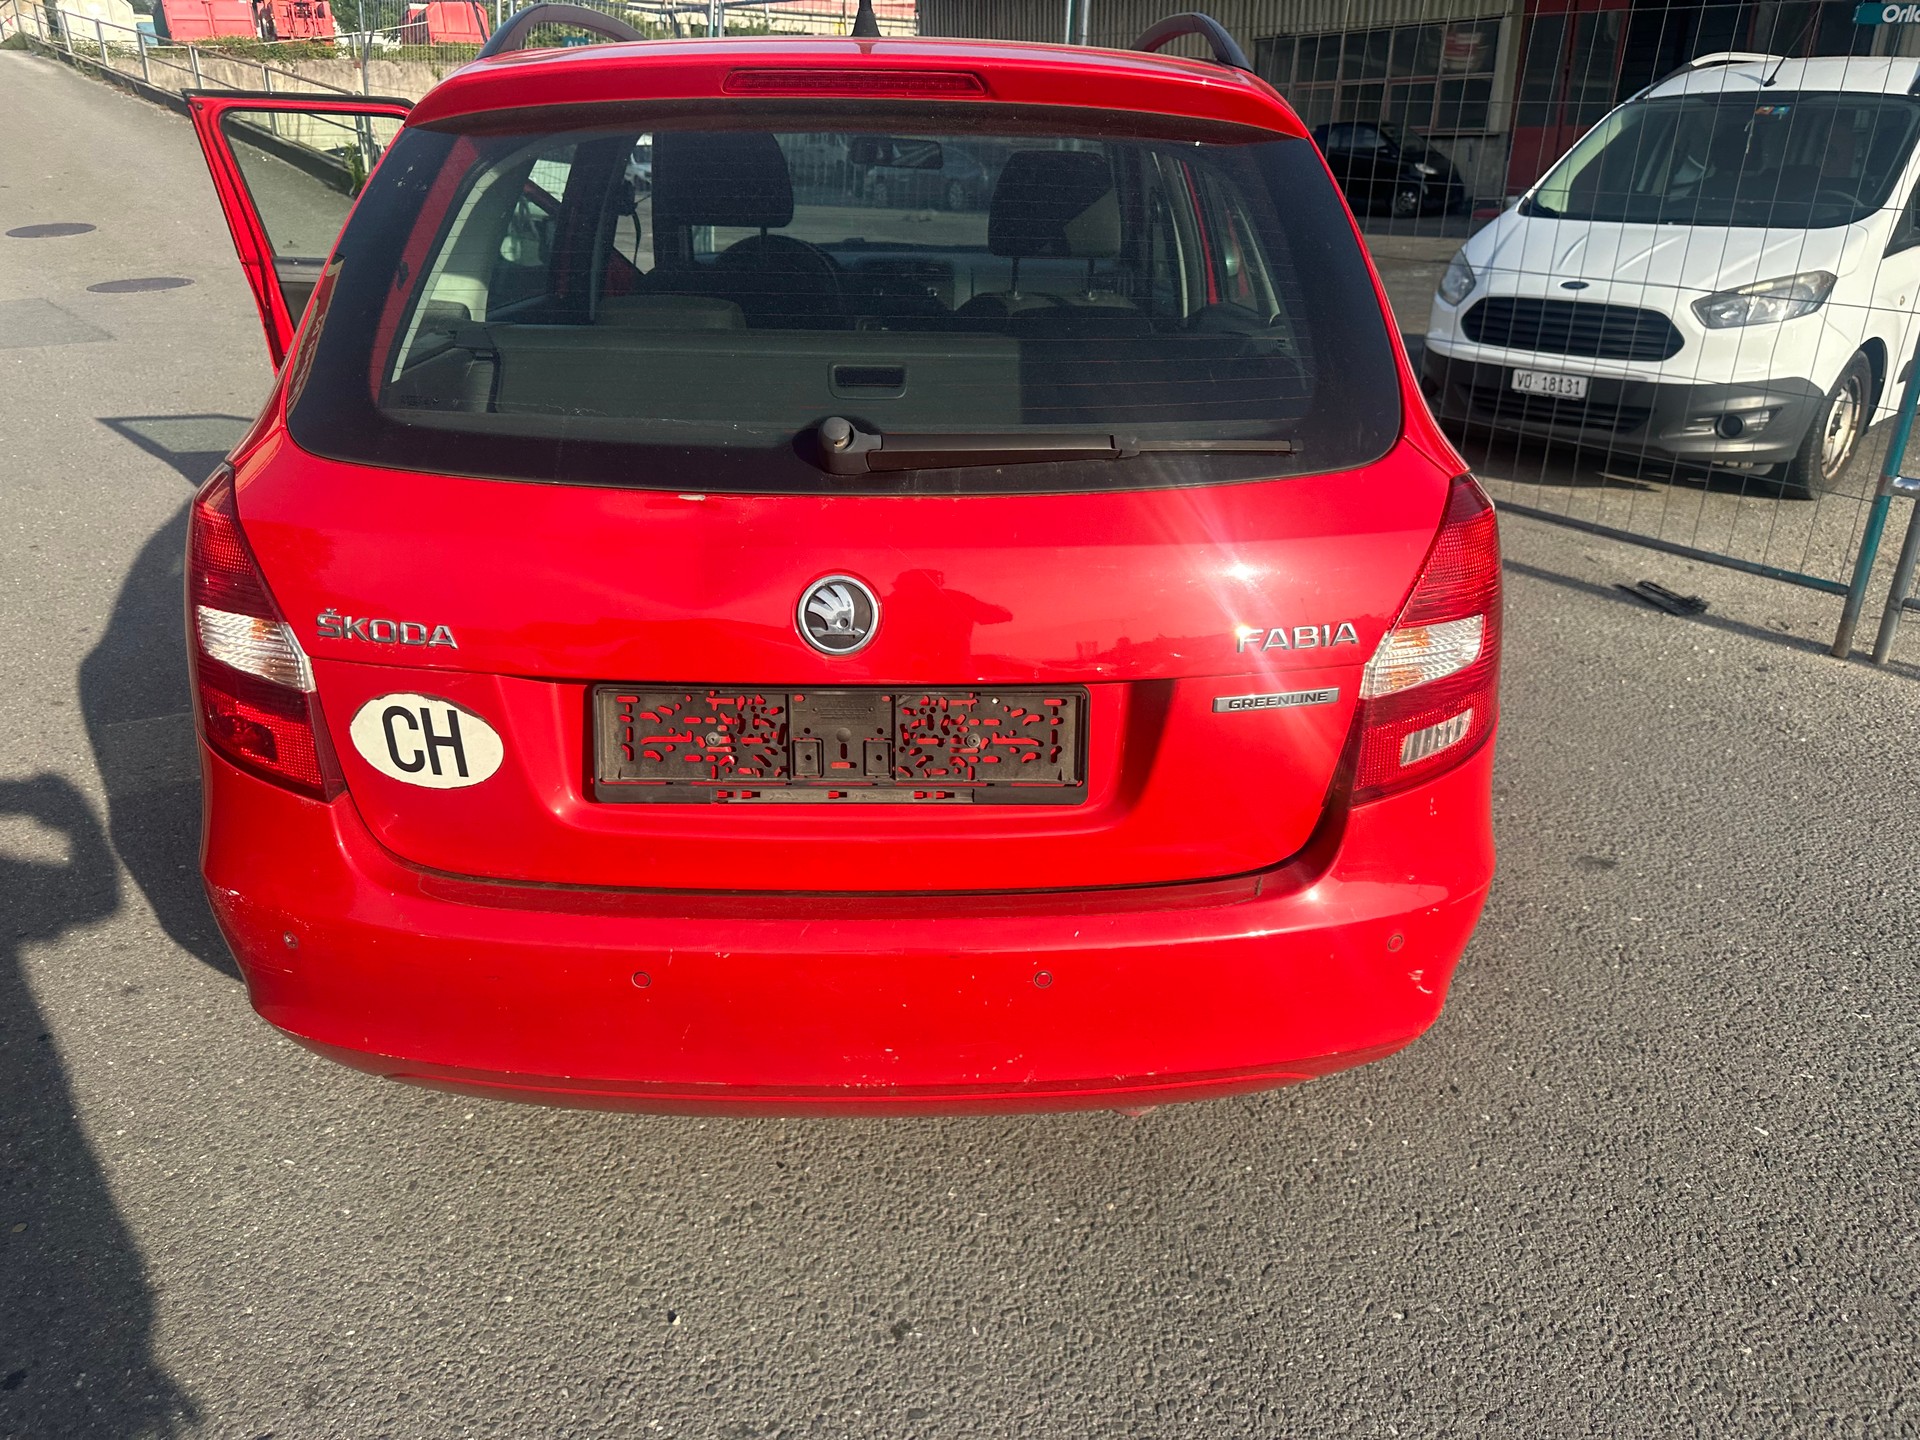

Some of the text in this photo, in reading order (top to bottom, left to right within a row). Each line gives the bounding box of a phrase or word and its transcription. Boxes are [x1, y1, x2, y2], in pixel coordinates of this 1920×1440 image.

[1542, 376, 1580, 395] 18131
[316, 608, 459, 650] ŠKODA
[1236, 622, 1360, 653] FABIA
[1228, 691, 1329, 709] GREENLINE
[382, 705, 469, 778] CH
